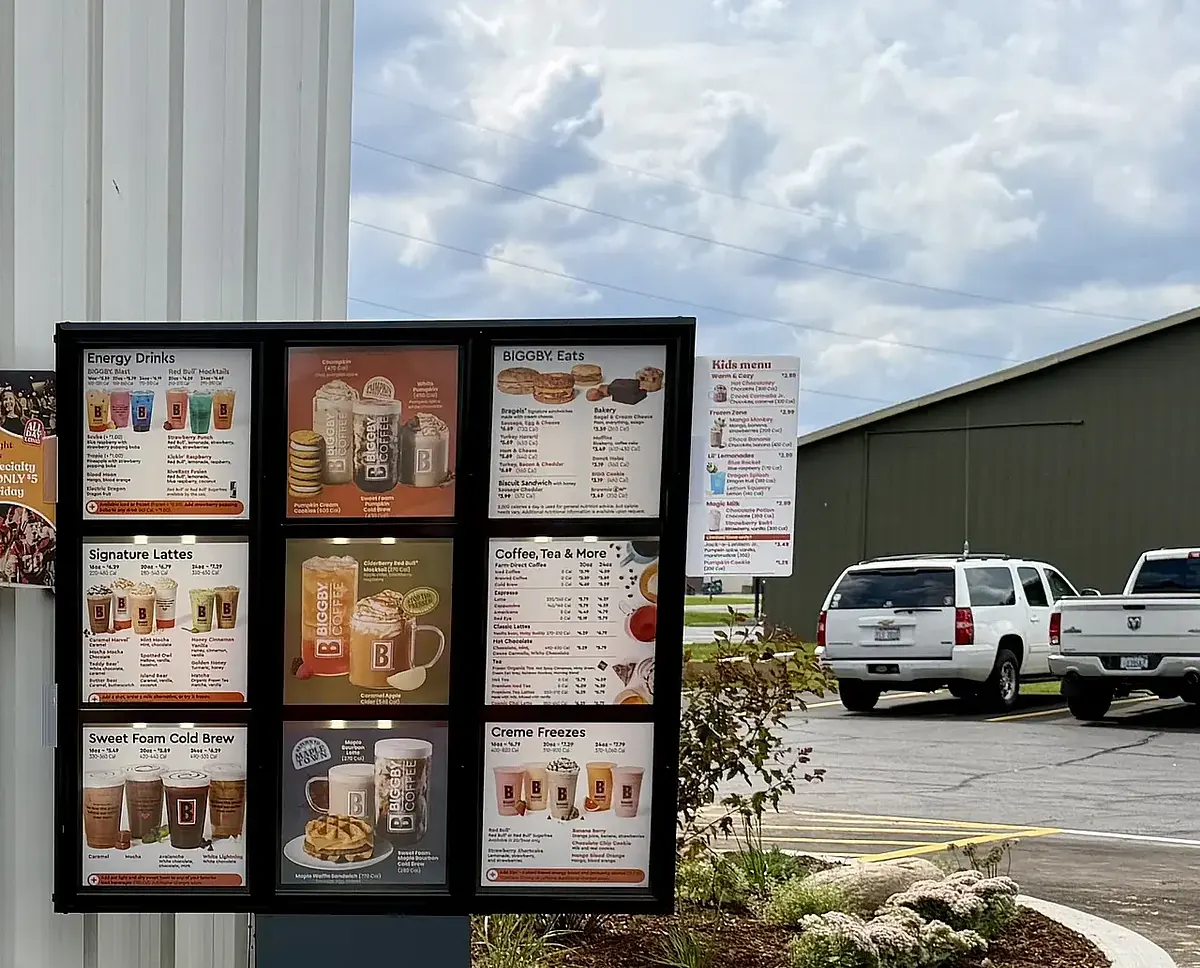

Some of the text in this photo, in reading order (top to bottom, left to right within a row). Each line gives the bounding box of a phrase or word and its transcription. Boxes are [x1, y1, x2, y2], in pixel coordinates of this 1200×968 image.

[87, 352, 175, 366] Energy Drinks
[558, 350, 584, 361] Eats
[712, 360, 771, 369] Kids menu
[26, 430, 41, 439] DAY
[27, 422, 41, 432] ALL
[326, 413, 335, 455] BIGGBY
[339, 412, 347, 456] COFFEE
[366, 417, 376, 462] BIGGBY
[379, 417, 389, 462] COFFEE
[418, 451, 430, 471] B
[27, 474, 38, 484] $5
[89, 549, 193, 562] Signature Lattes
[495, 548, 607, 560] Coffee, Tea & More
[317, 583, 329, 635] BIGGBY
[332, 582, 344, 635] COFFEE
[318, 641, 340, 654] B
[376, 644, 389, 667] B
[89, 732, 234, 744] Sweet Foam Cold Brew
[491, 727, 586, 738] Creme Freezes
[295, 745, 324, 761] MAPLE
[296, 752, 327, 766] TOWN
[390, 761, 400, 811] BIGGBY
[405, 760, 416, 811] COFFEE
[182, 801, 193, 820] B
[350, 792, 362, 815] B
[390, 817, 413, 829] B
